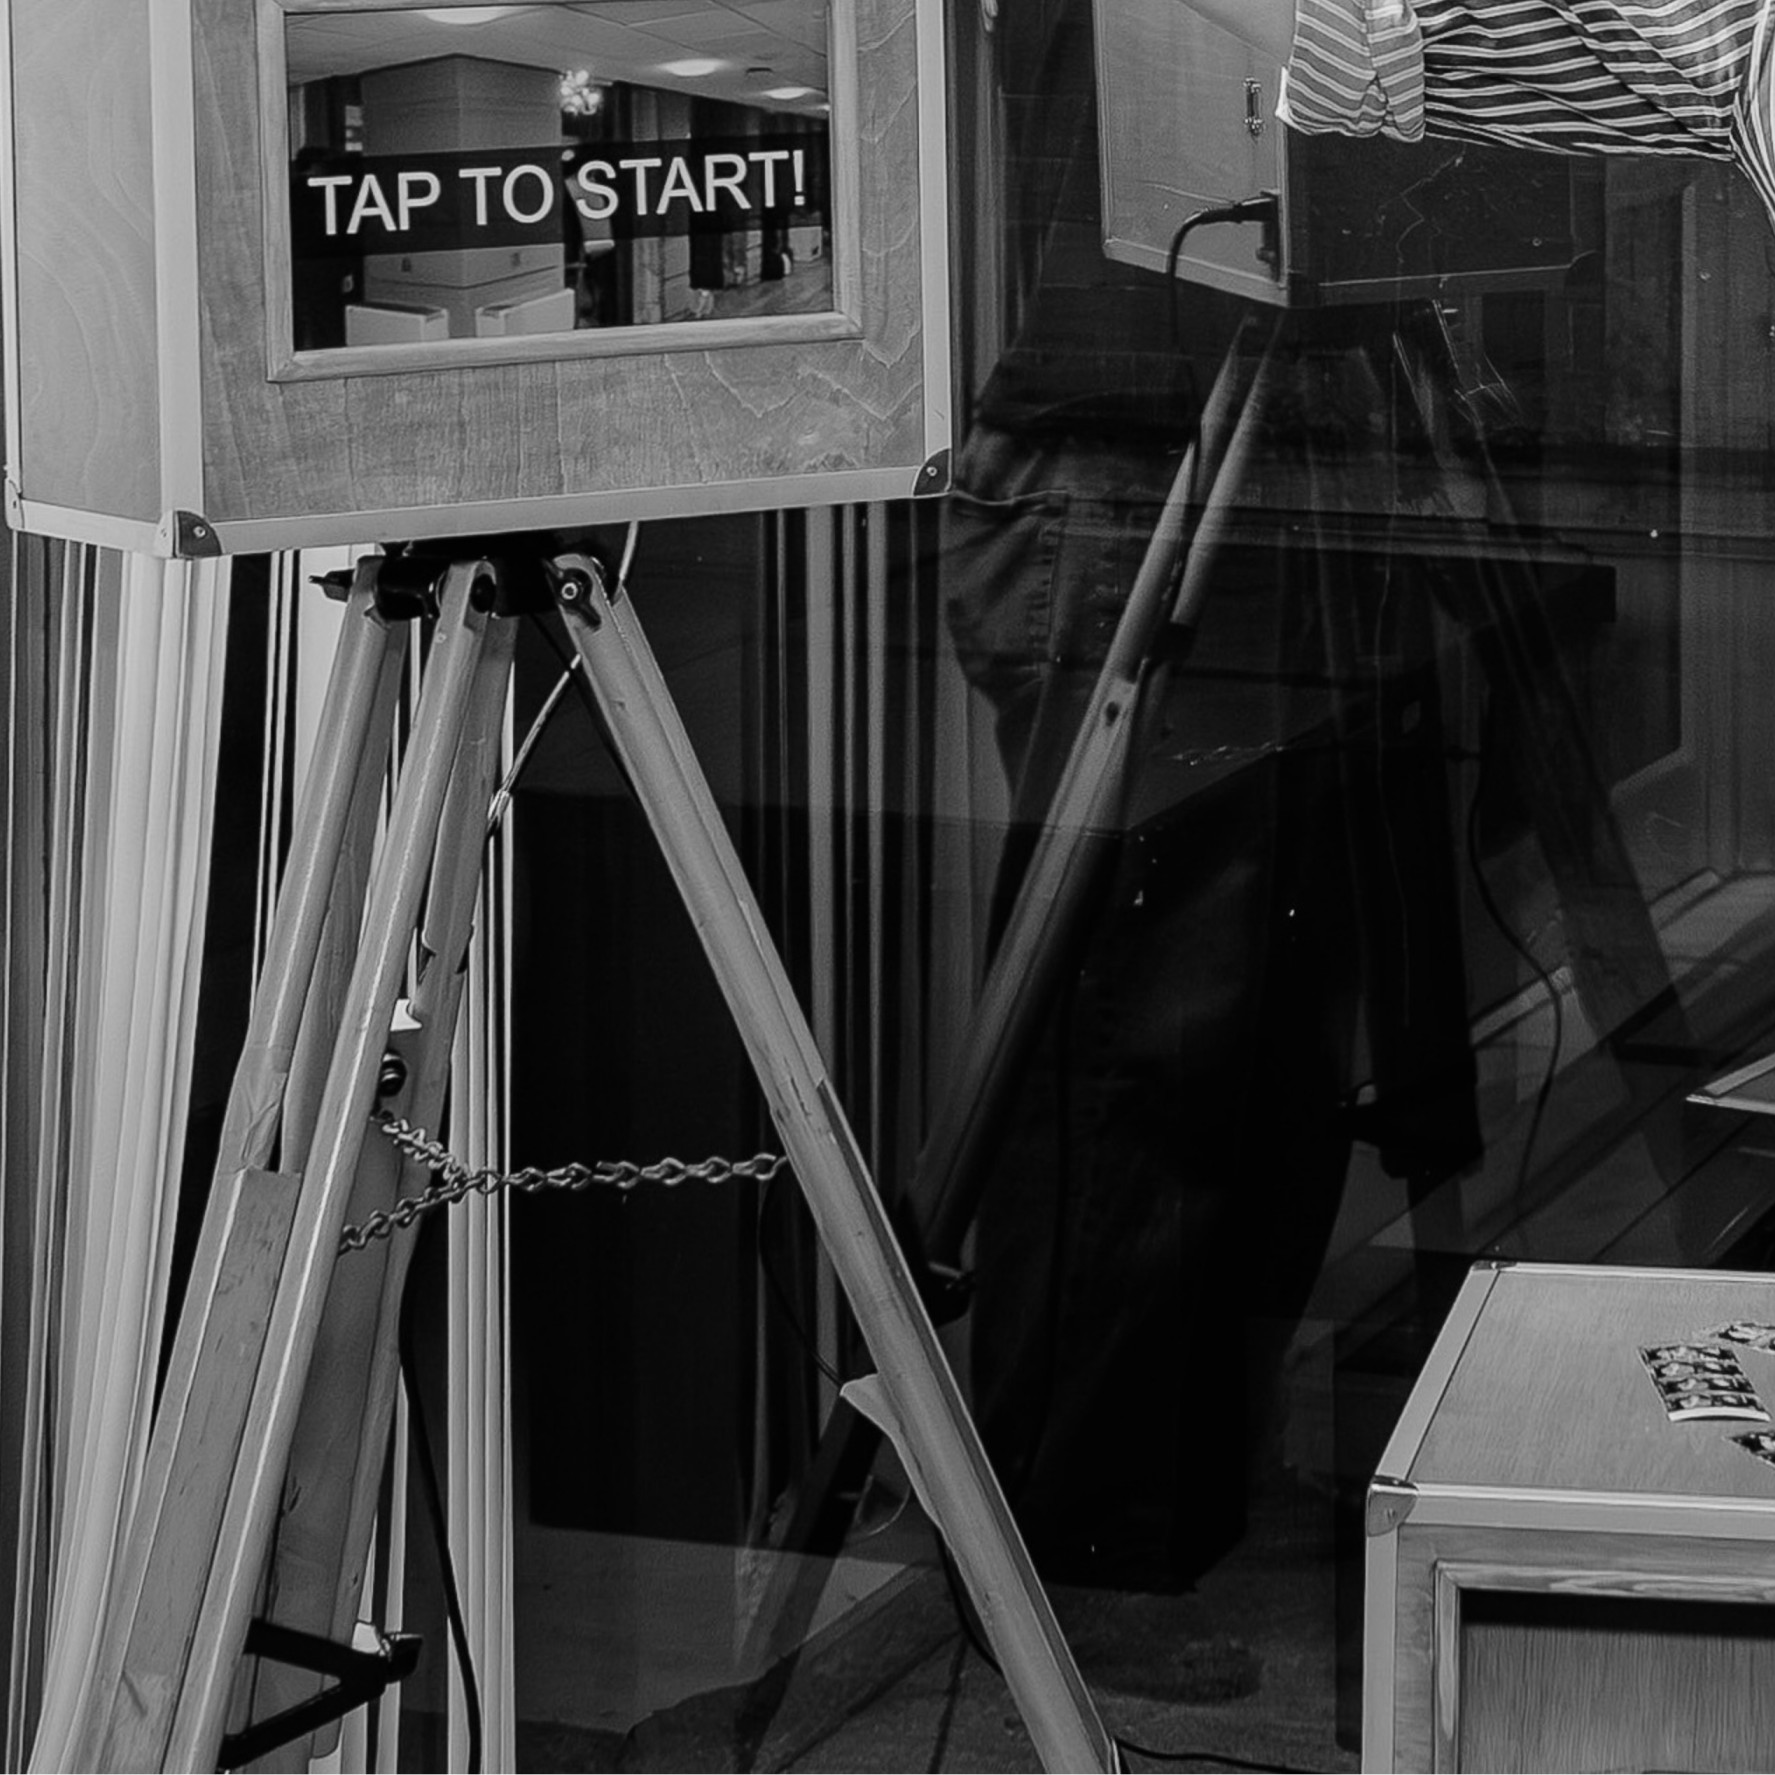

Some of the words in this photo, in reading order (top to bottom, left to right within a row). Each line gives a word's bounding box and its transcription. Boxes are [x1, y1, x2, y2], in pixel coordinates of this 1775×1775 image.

[307, 171, 440, 236] TAP
[458, 165, 555, 226] TO
[575, 149, 806, 219] START!
